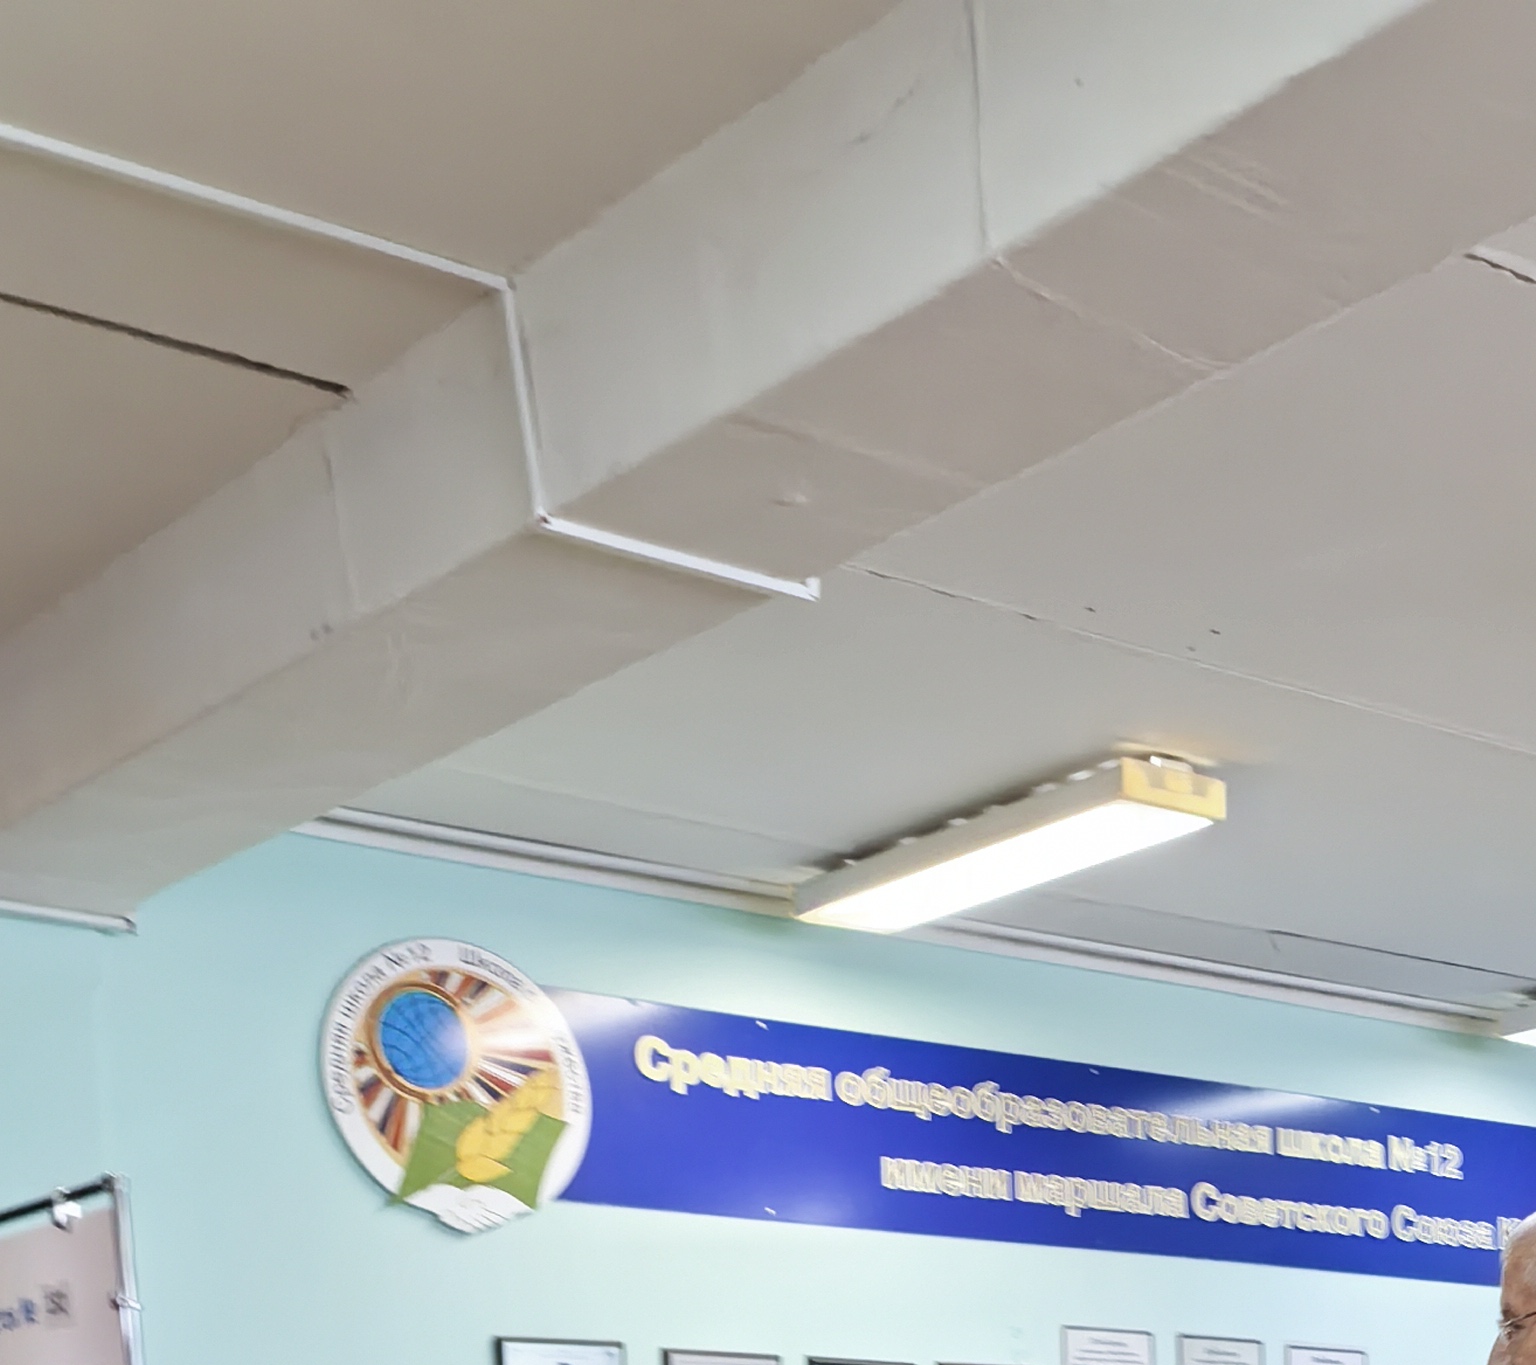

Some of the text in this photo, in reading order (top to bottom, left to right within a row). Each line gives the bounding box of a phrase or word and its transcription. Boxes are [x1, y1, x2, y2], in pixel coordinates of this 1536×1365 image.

[634, 1034, 833, 1102] Средняя
[834, 1066, 1275, 1156] общеобразовательная
[1275, 1127, 1388, 1171] школа
[1387, 1134, 1466, 1181] №12
[879, 1155, 1013, 1202] имени
[1013, 1170, 1191, 1219] маршала
[1190, 1181, 1391, 1241] Советского
[1390, 1204, 1497, 1250] Союза
